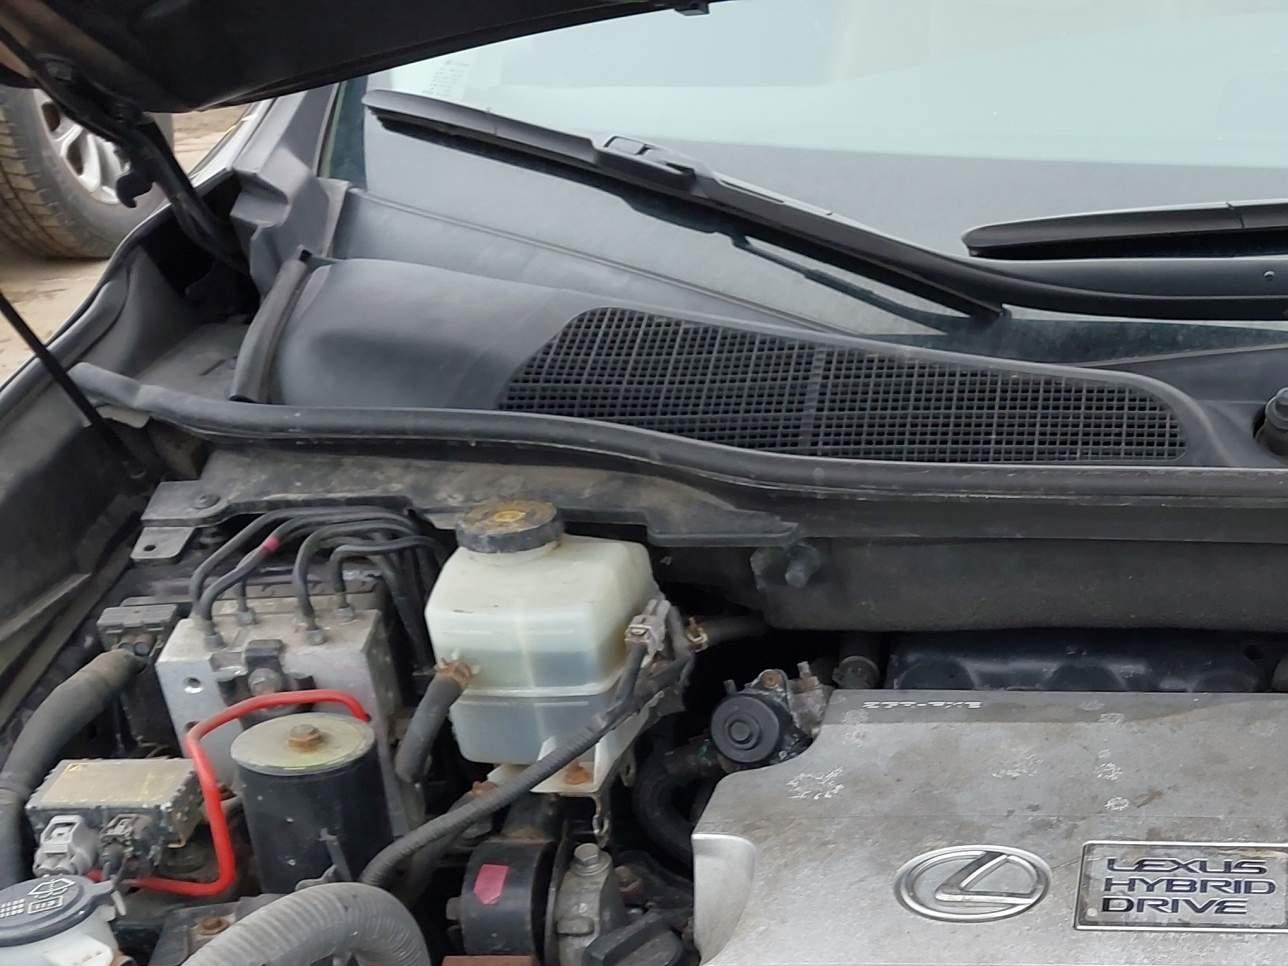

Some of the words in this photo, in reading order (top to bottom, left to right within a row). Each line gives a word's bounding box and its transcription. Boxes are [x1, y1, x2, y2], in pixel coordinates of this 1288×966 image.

[1106, 857, 1268, 874] LEXUS
[1103, 875, 1277, 895] HYBRID
[1101, 896, 1249, 915] DRIVE
